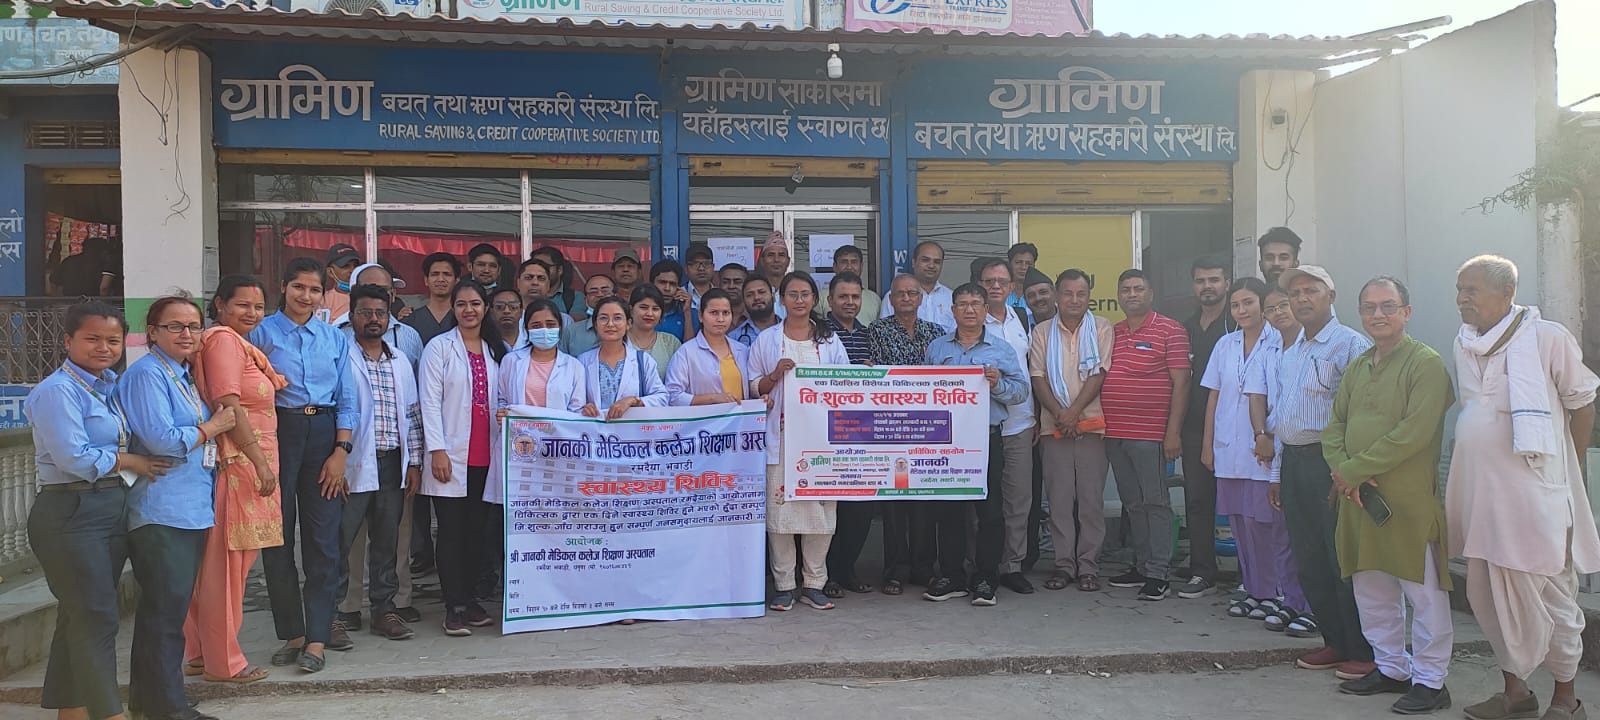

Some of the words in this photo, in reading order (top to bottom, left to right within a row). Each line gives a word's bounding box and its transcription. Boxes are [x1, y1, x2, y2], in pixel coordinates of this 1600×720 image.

[584, 2, 608, 13] Rural
[610, 3, 641, 15] Saving
[643, 4, 650, 13] &
[652, 4, 679, 14] Credit
[681, 5, 733, 17] Cooperative
[735, 6, 767, 18] Society
[220, 64, 375, 122] ग्रामिण
[381, 93, 431, 120] बचत
[433, 95, 468, 120] तथा
[470, 96, 505, 116] ऋण
[507, 92, 576, 124] सहकारी
[579, 94, 632, 123] संस्था
[634, 93, 660, 123] लि.
[684, 67, 777, 104] ग्रामिण
[988, 66, 1166, 119] ग्रामिण
[379, 123, 422, 140] RURAL
[424, 124, 465, 140] SAVING
[466, 127, 476, 142] &
[477, 125, 519, 141] CREDIT
[521, 127, 590, 144] COOPERATIVE
[592, 128, 639, 145] SOCIETY
[640, 129, 662, 145] LTD.
[797, 115, 870, 146] स्वागत
[914, 121, 975, 156] बचत
[974, 123, 1023, 156] तथा
[1025, 123, 1070, 152] ऋण
[1068, 116, 1149, 157] सहकारी
[1153, 117, 1214, 158] संस्था
[1216, 126, 1237, 155] लि.
[869, 391, 928, 406] स्वास्थ्य
[932, 387, 980, 406] शिविर
[541, 432, 592, 459] जानकी
[596, 433, 651, 460] मेडिकल
[655, 431, 697, 457] कलेज
[698, 430, 737, 455] शिक्षण
[938, 447, 966, 455] सहयोग
[909, 456, 950, 467] जानकी
[577, 478, 668, 497] स्वास्थ्य
[675, 470, 739, 493] शिविर
[510, 498, 541, 508] जानकी
[544, 498, 579, 509] मेडिकल
[583, 498, 609, 509] कलेज
[612, 498, 641, 508] शिक्षण
[642, 496, 679, 507] अस्पताल
[514, 510, 559, 520] चिकित्सक
[562, 511, 581, 521] द्वारा
[583, 511, 599, 519] एक
[602, 509, 619, 520] दिने
[622, 508, 654, 519] स्वास्थ्य
[656, 505, 680, 517] शिविर
[681, 504, 694, 516] हुने
[696, 502, 720, 514] भएको
[554, 521, 573, 531] जाँच
[576, 523, 607, 533] गराउनु
[609, 522, 624, 532] हुन
[626, 519, 653, 531] सम्पूर्ण
[717, 511, 753, 522] जानकारी
[565, 535, 603, 546] आयोजक
[510, 549, 519, 564] श्री
[521, 548, 546, 562] जानकी
[547, 547, 576, 561] मेडिकल
[578, 548, 600, 561] कलेज
[601, 547, 625, 561] शिक्षण
[625, 547, 656, 560] अस्पताल
